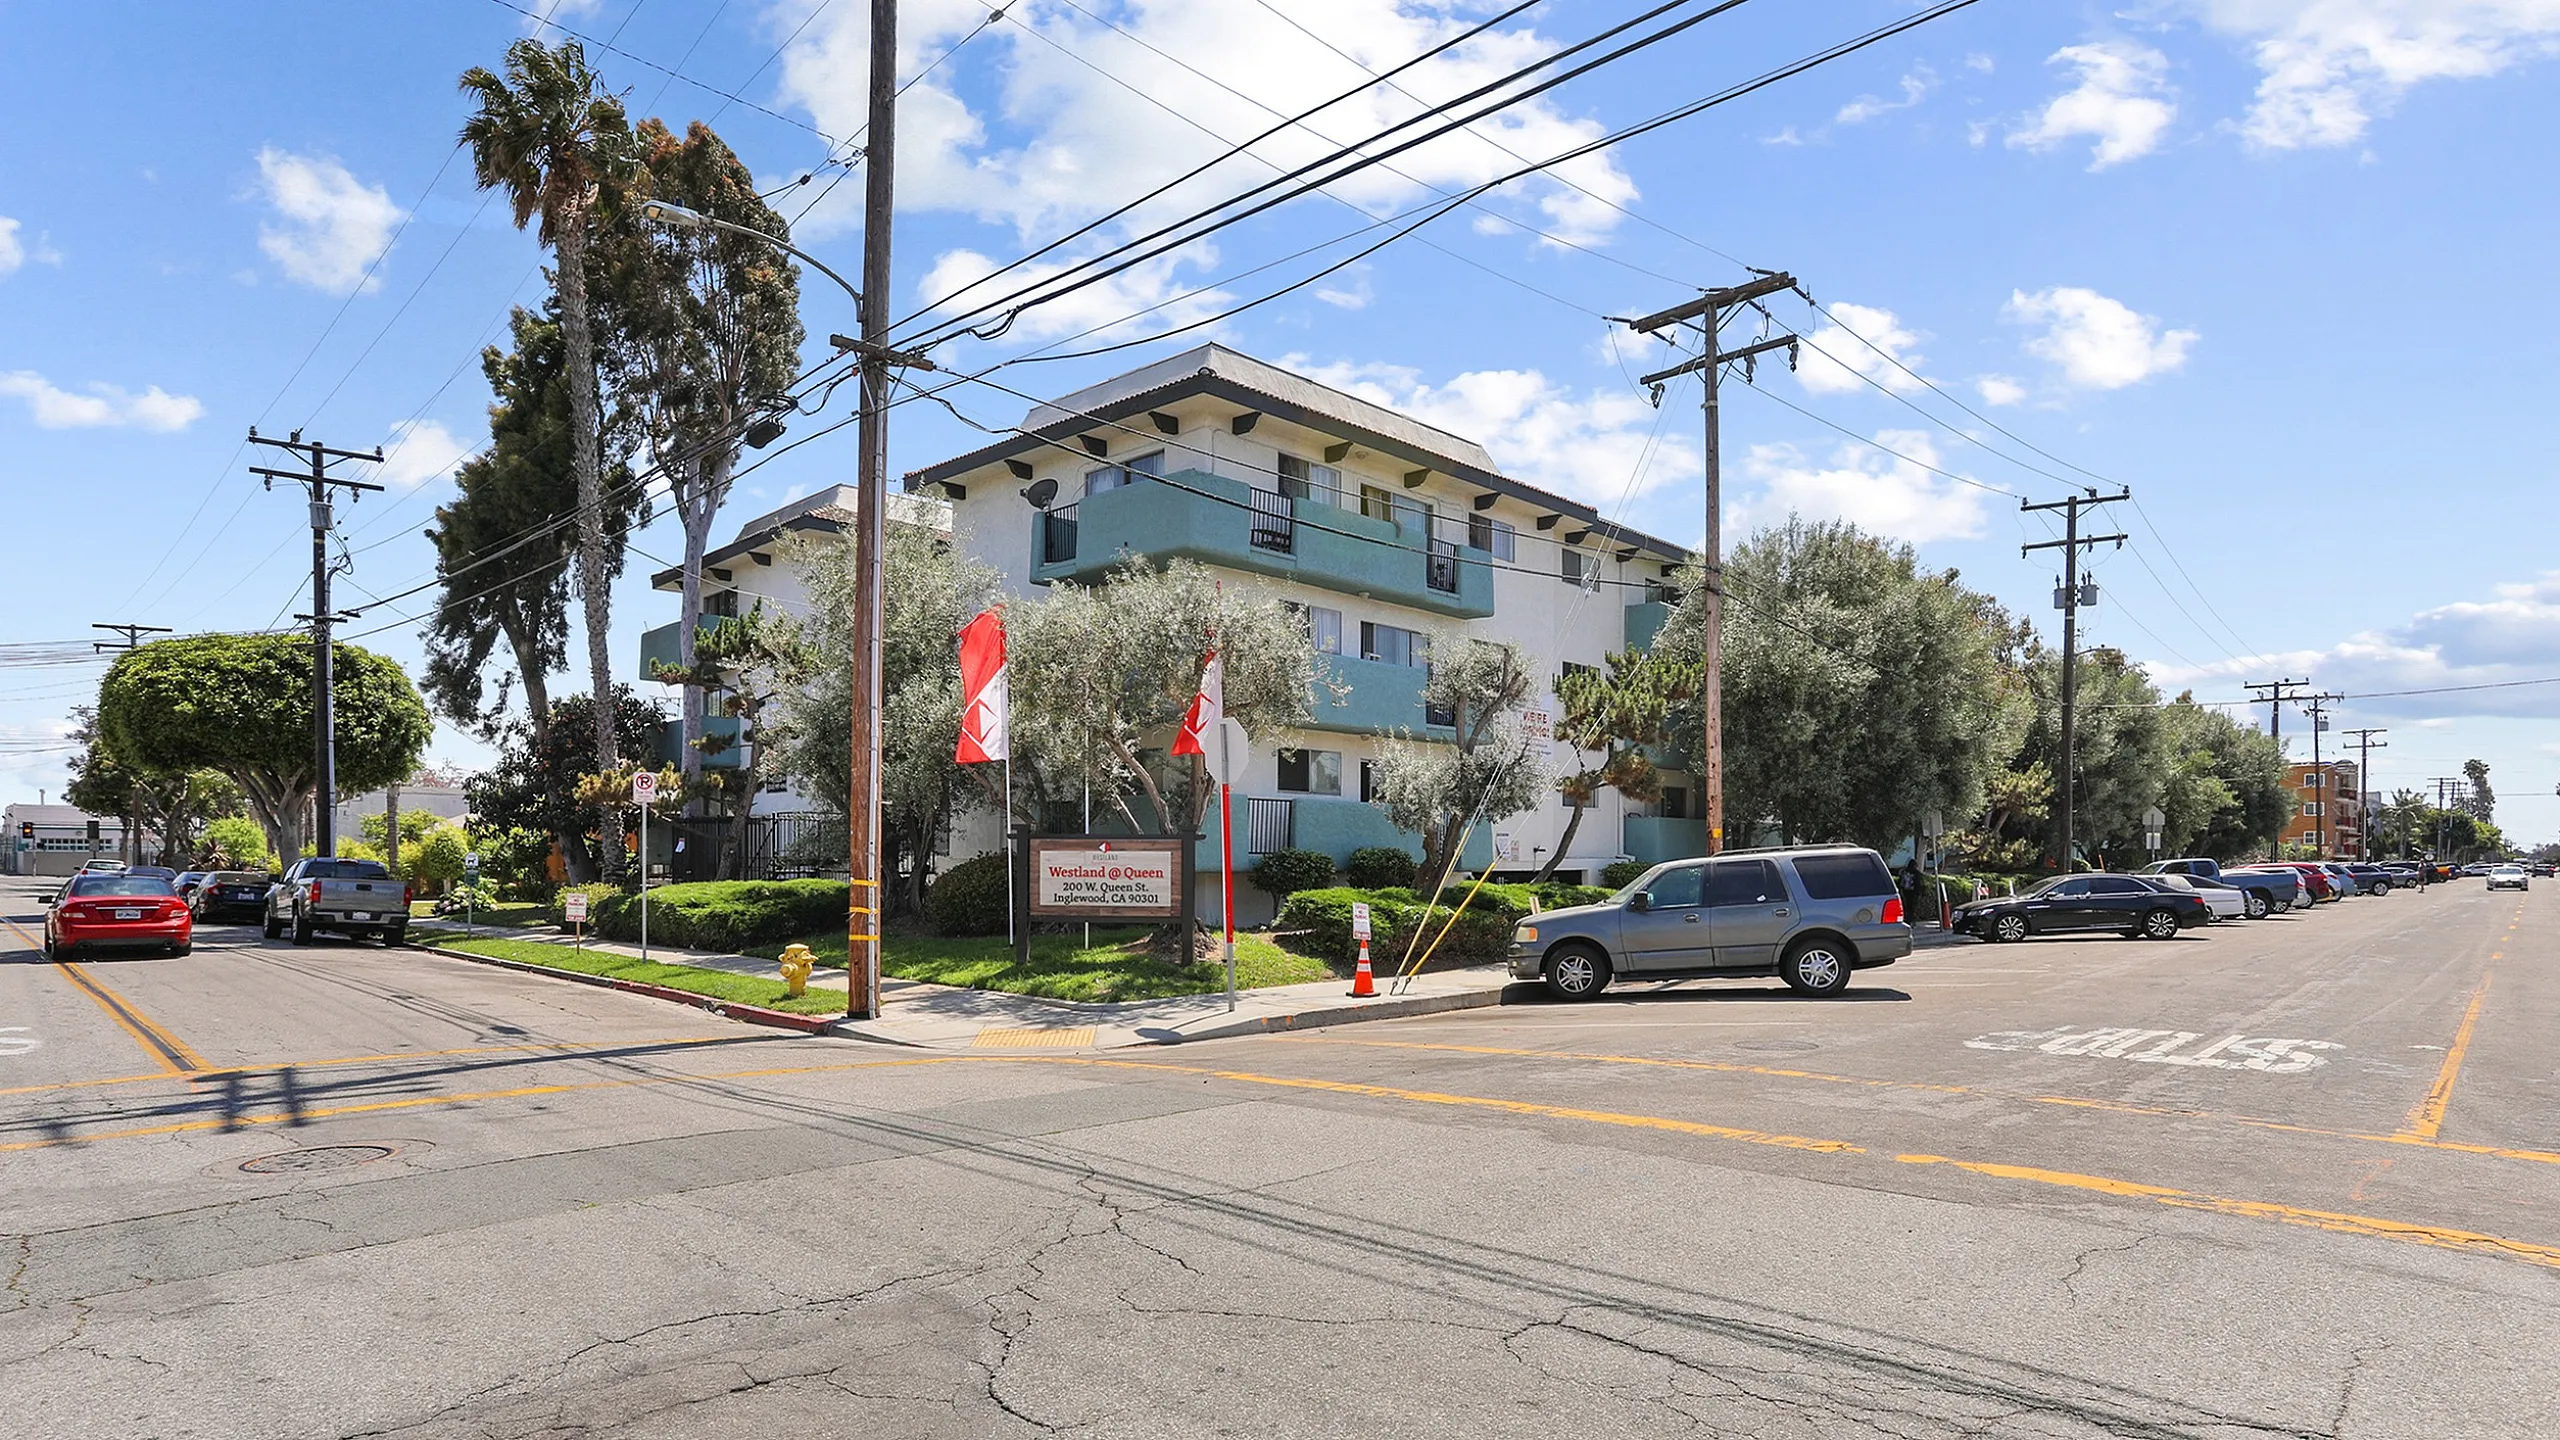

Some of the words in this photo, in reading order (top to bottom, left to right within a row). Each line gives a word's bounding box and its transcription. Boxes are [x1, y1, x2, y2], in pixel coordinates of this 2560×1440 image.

[1049, 866, 1106, 878] Westland
[1108, 867, 1122, 880] @
[1124, 867, 1164, 880] Queen
[1063, 882, 1083, 892] 200
[1085, 882, 1098, 892] W.
[1100, 882, 1133, 893] Queen
[1135, 882, 1149, 892] St.
[1054, 893, 1110, 906] Inglewood,
[1112, 894, 1126, 903] CA
[1128, 894, 1159, 904] 90301
